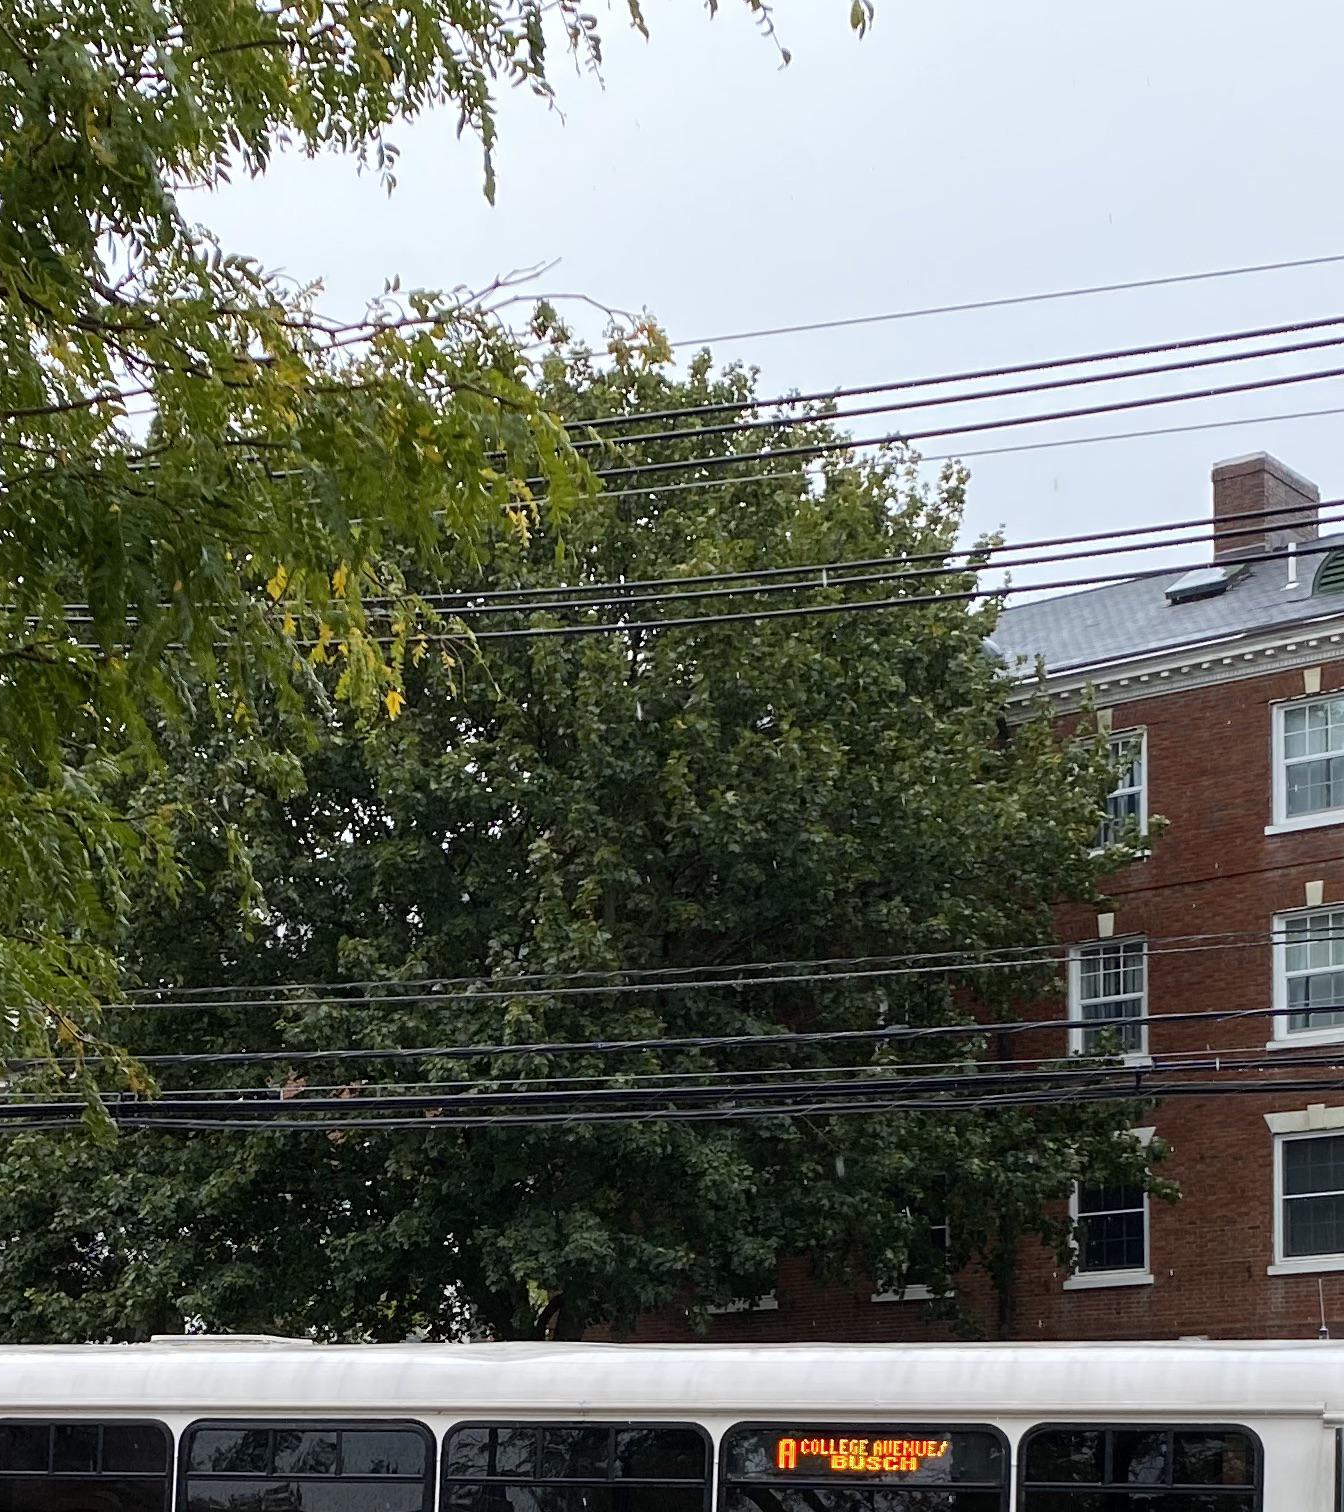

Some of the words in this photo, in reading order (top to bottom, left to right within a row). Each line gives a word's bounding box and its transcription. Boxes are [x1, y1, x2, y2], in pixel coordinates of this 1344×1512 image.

[777, 1437, 797, 1470] A
[800, 1438, 870, 1457] COLLEGE
[830, 1455, 919, 1472] BUSCH
